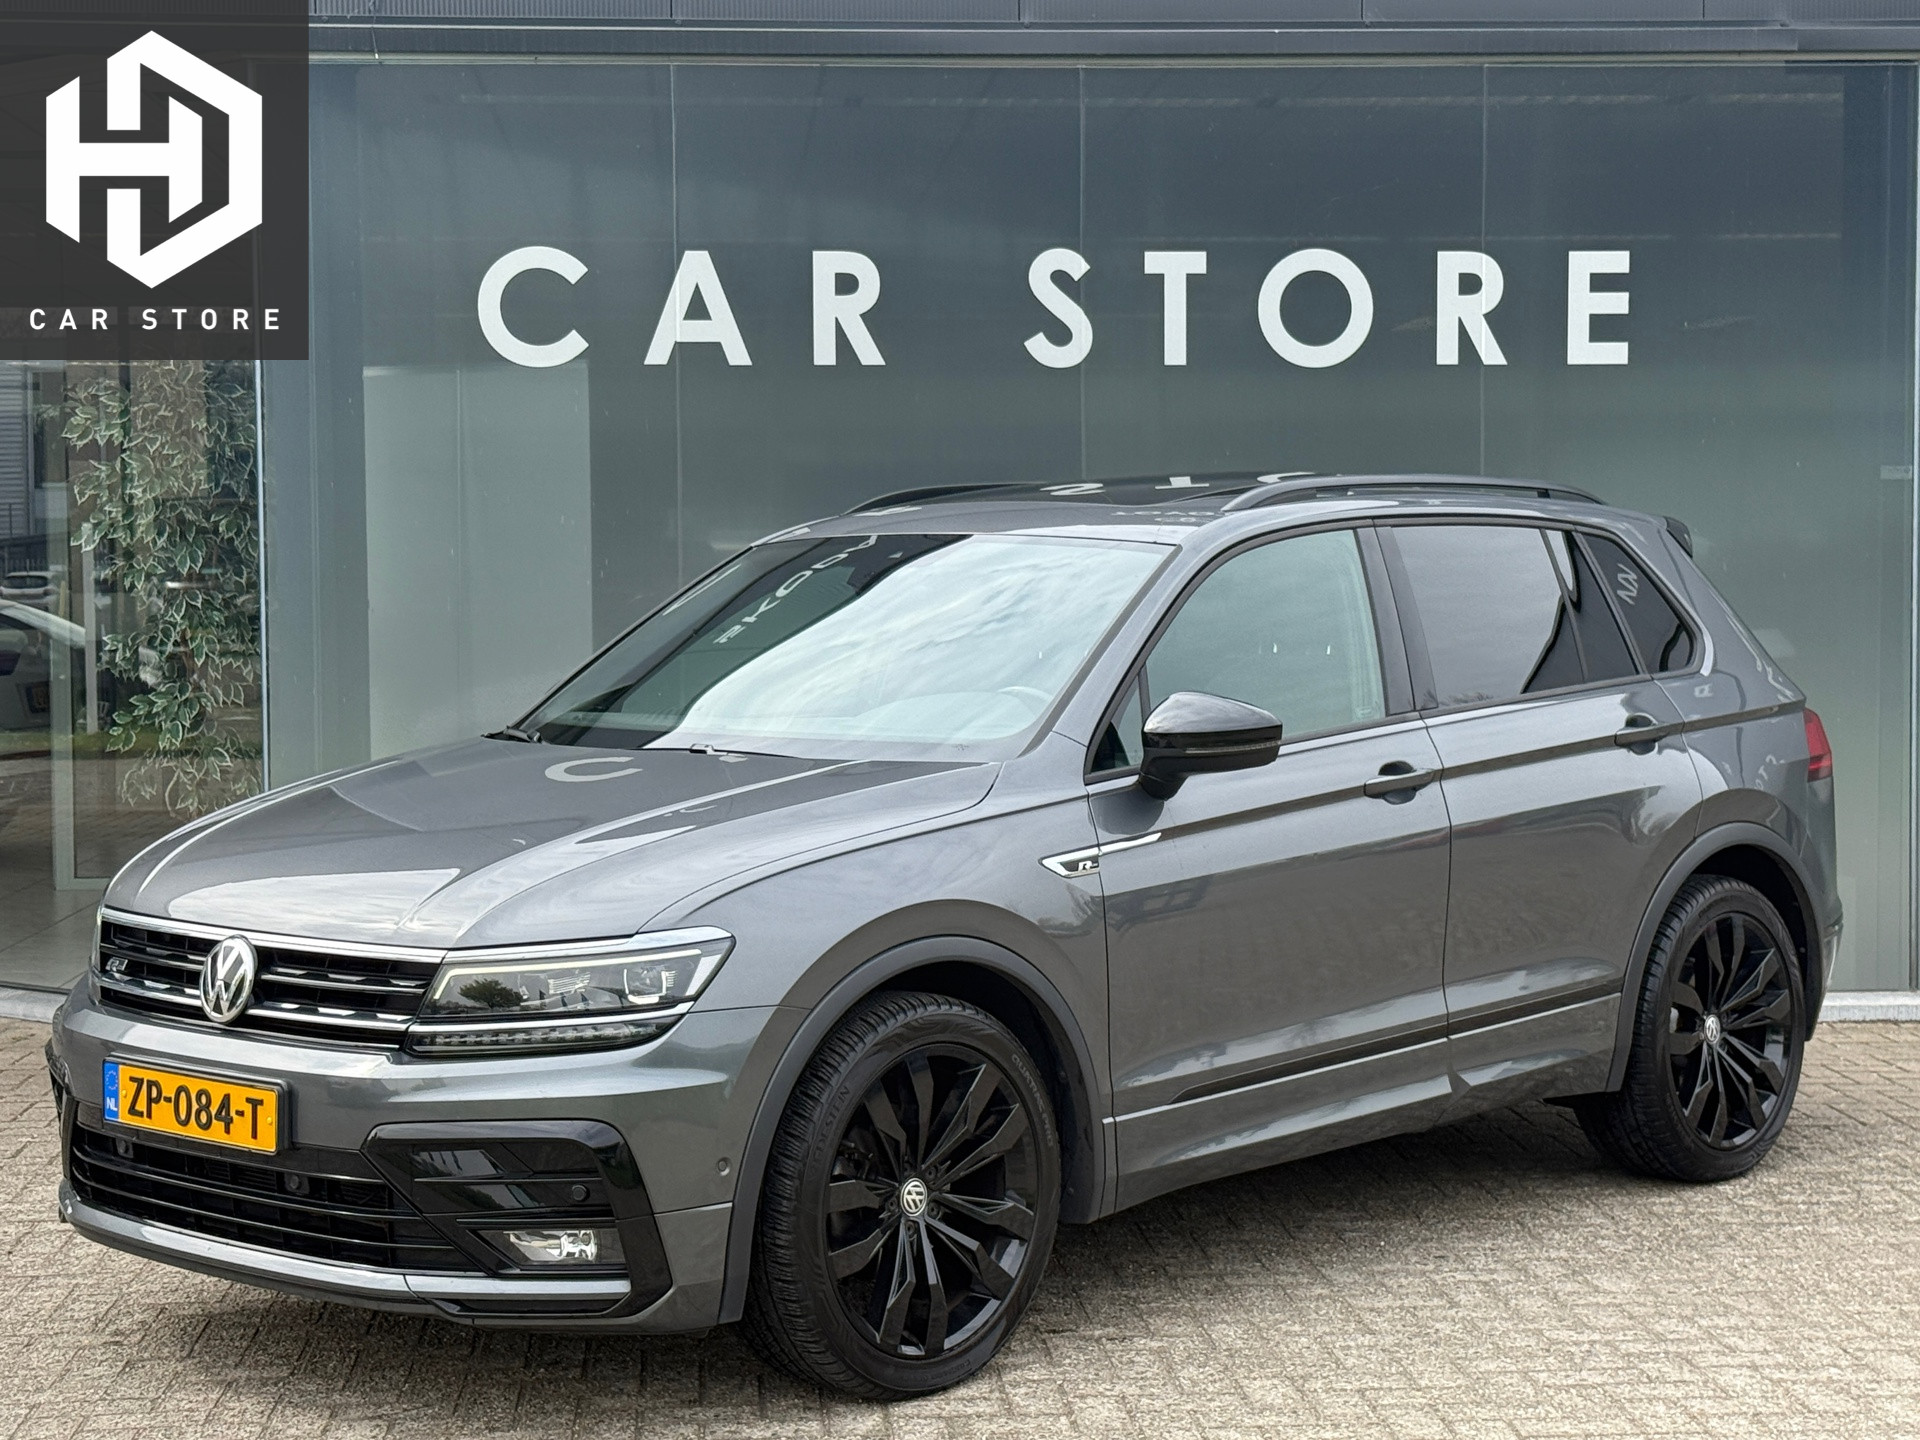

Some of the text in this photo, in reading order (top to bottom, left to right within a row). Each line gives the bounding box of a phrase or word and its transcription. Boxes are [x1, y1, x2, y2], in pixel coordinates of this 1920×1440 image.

[476, 246, 1632, 368] CAR STORE
[106, 1096, 118, 1112] NL
[127, 1075, 264, 1141] ZP-084-T
